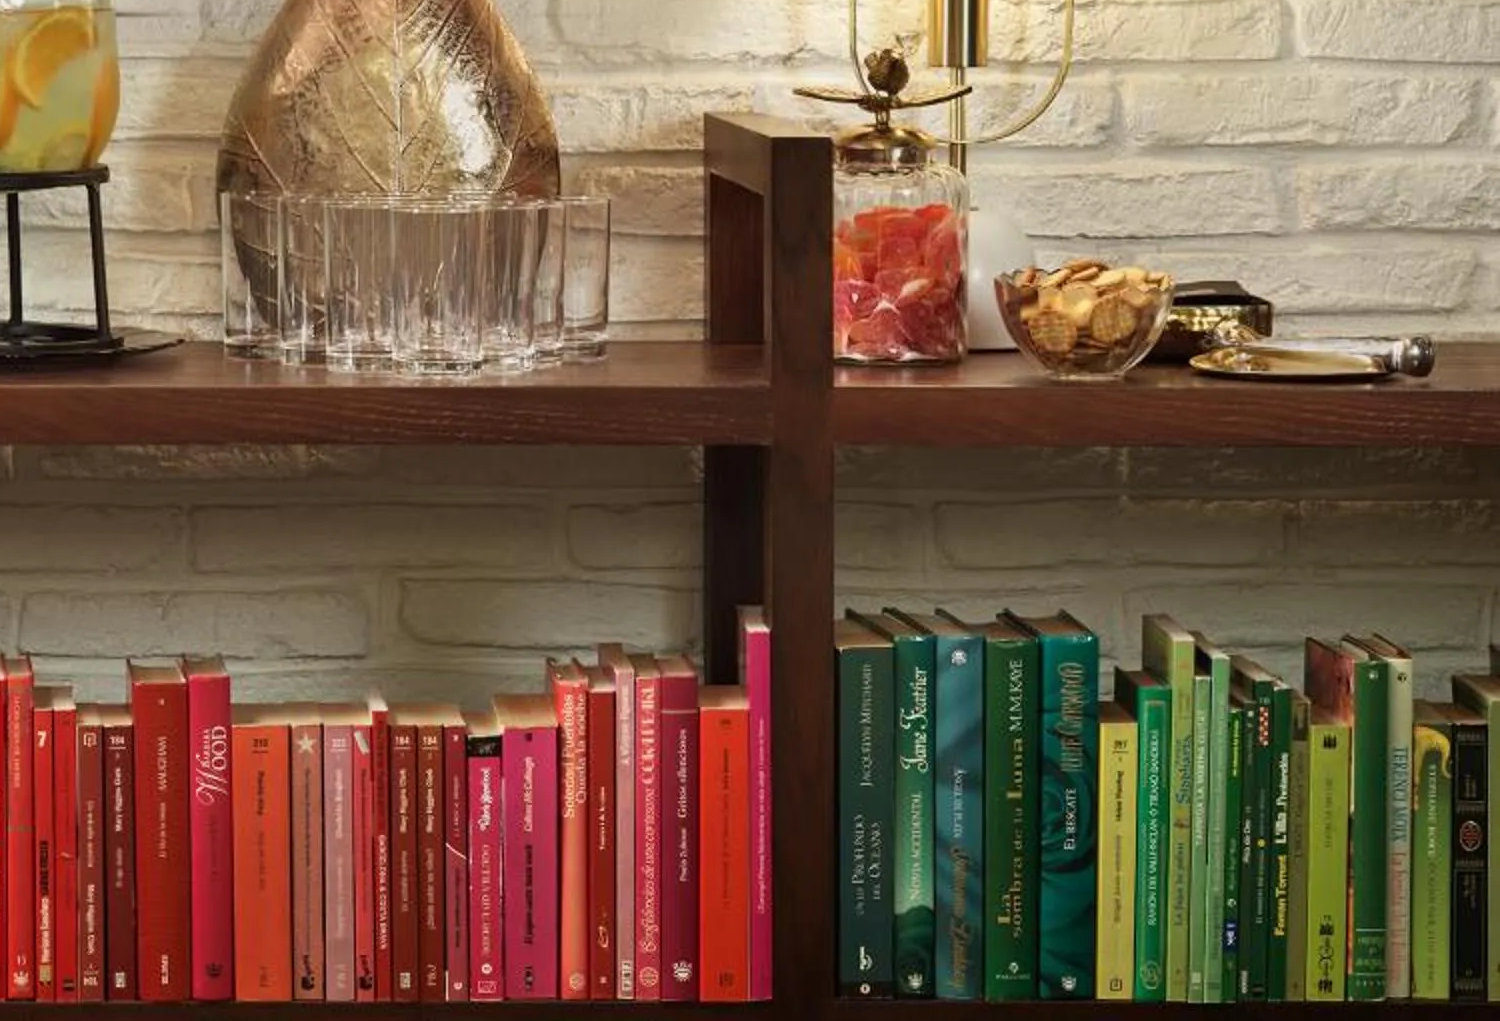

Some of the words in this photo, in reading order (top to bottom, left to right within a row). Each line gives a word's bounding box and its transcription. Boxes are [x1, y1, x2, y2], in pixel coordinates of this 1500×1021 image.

[562, 693, 575, 759] Puértolas
[899, 666, 928, 730] Feather
[195, 725, 228, 805] WOOD
[575, 754, 587, 804] Queda
[899, 731, 928, 773] Jane
[1008, 738, 1023, 800] Luna
[1391, 746, 1409, 804] TERENCI
[562, 761, 575, 819] Soledad
[1064, 787, 1077, 833] RESCATE
[1064, 836, 1077, 850] EL
[1391, 807, 1409, 845] MOIX
[997, 892, 1011, 924] La
[1008, 857, 1023, 938] sombra
